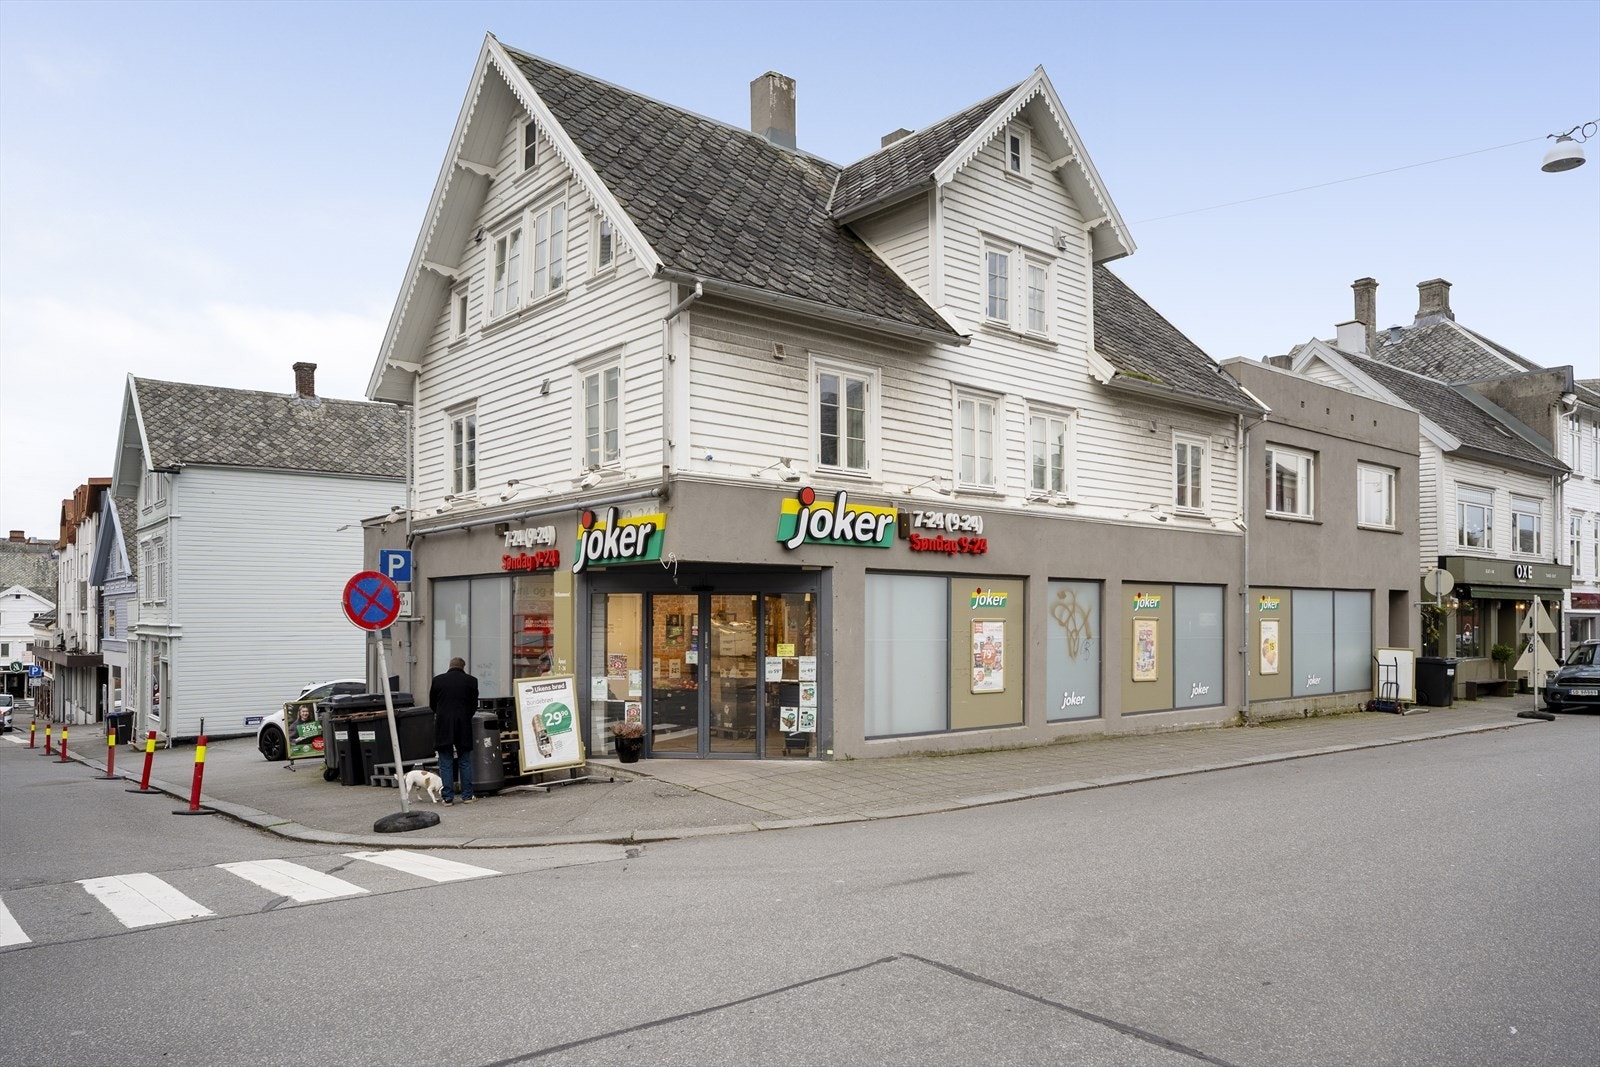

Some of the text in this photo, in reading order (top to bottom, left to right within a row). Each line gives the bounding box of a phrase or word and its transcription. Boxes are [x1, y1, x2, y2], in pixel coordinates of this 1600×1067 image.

[785, 487, 893, 550] joker
[913, 510, 984, 535] 7-24 (9-24)
[572, 506, 656, 575] joker
[910, 533, 988, 555] Søndag 9-24
[388, 554, 405, 578] P
[502, 553, 533, 572] Søndag
[1516, 565, 1533, 579] OXE
[972, 588, 1006, 610] joker
[1134, 592, 1160, 611] joker
[1260, 595, 1280, 612] joker
[1191, 682, 1210, 698] joker
[1307, 674, 1321, 688] joker
[1061, 692, 1086, 710] joker
